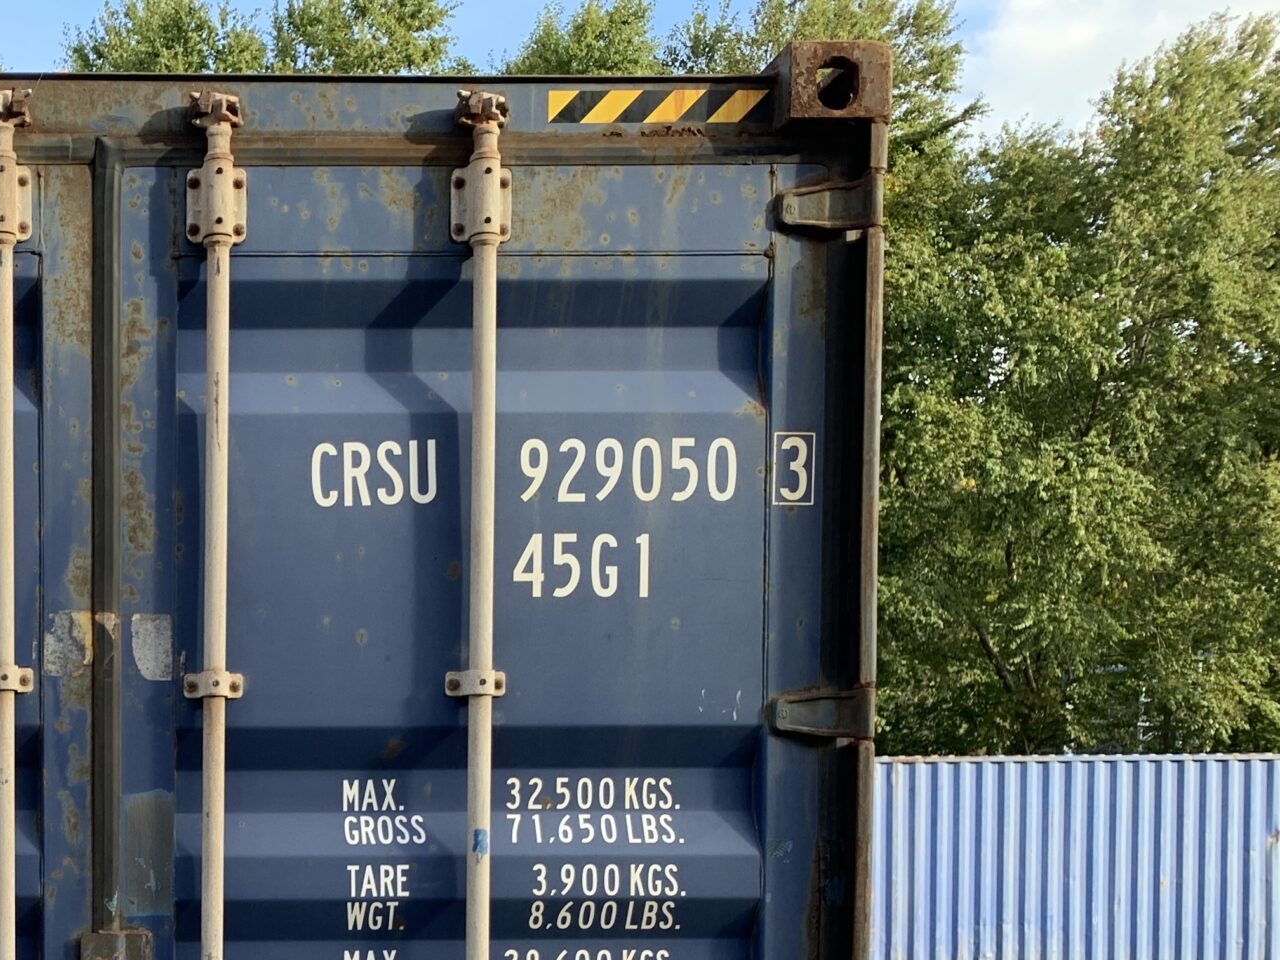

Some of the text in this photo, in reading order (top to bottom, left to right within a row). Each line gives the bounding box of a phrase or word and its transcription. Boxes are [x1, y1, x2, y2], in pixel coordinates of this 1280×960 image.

[310, 436, 808, 507] CRSU 929050 3
[513, 532, 650, 599] 45G1
[343, 779, 404, 811] MAX.
[624, 777, 680, 810] KGS.
[344, 814, 685, 845] GROSS 71,650 LBS.
[347, 864, 686, 898] TARE 3,900 KGS.
[347, 901, 681, 931] WGT. 8,600 LBS.
